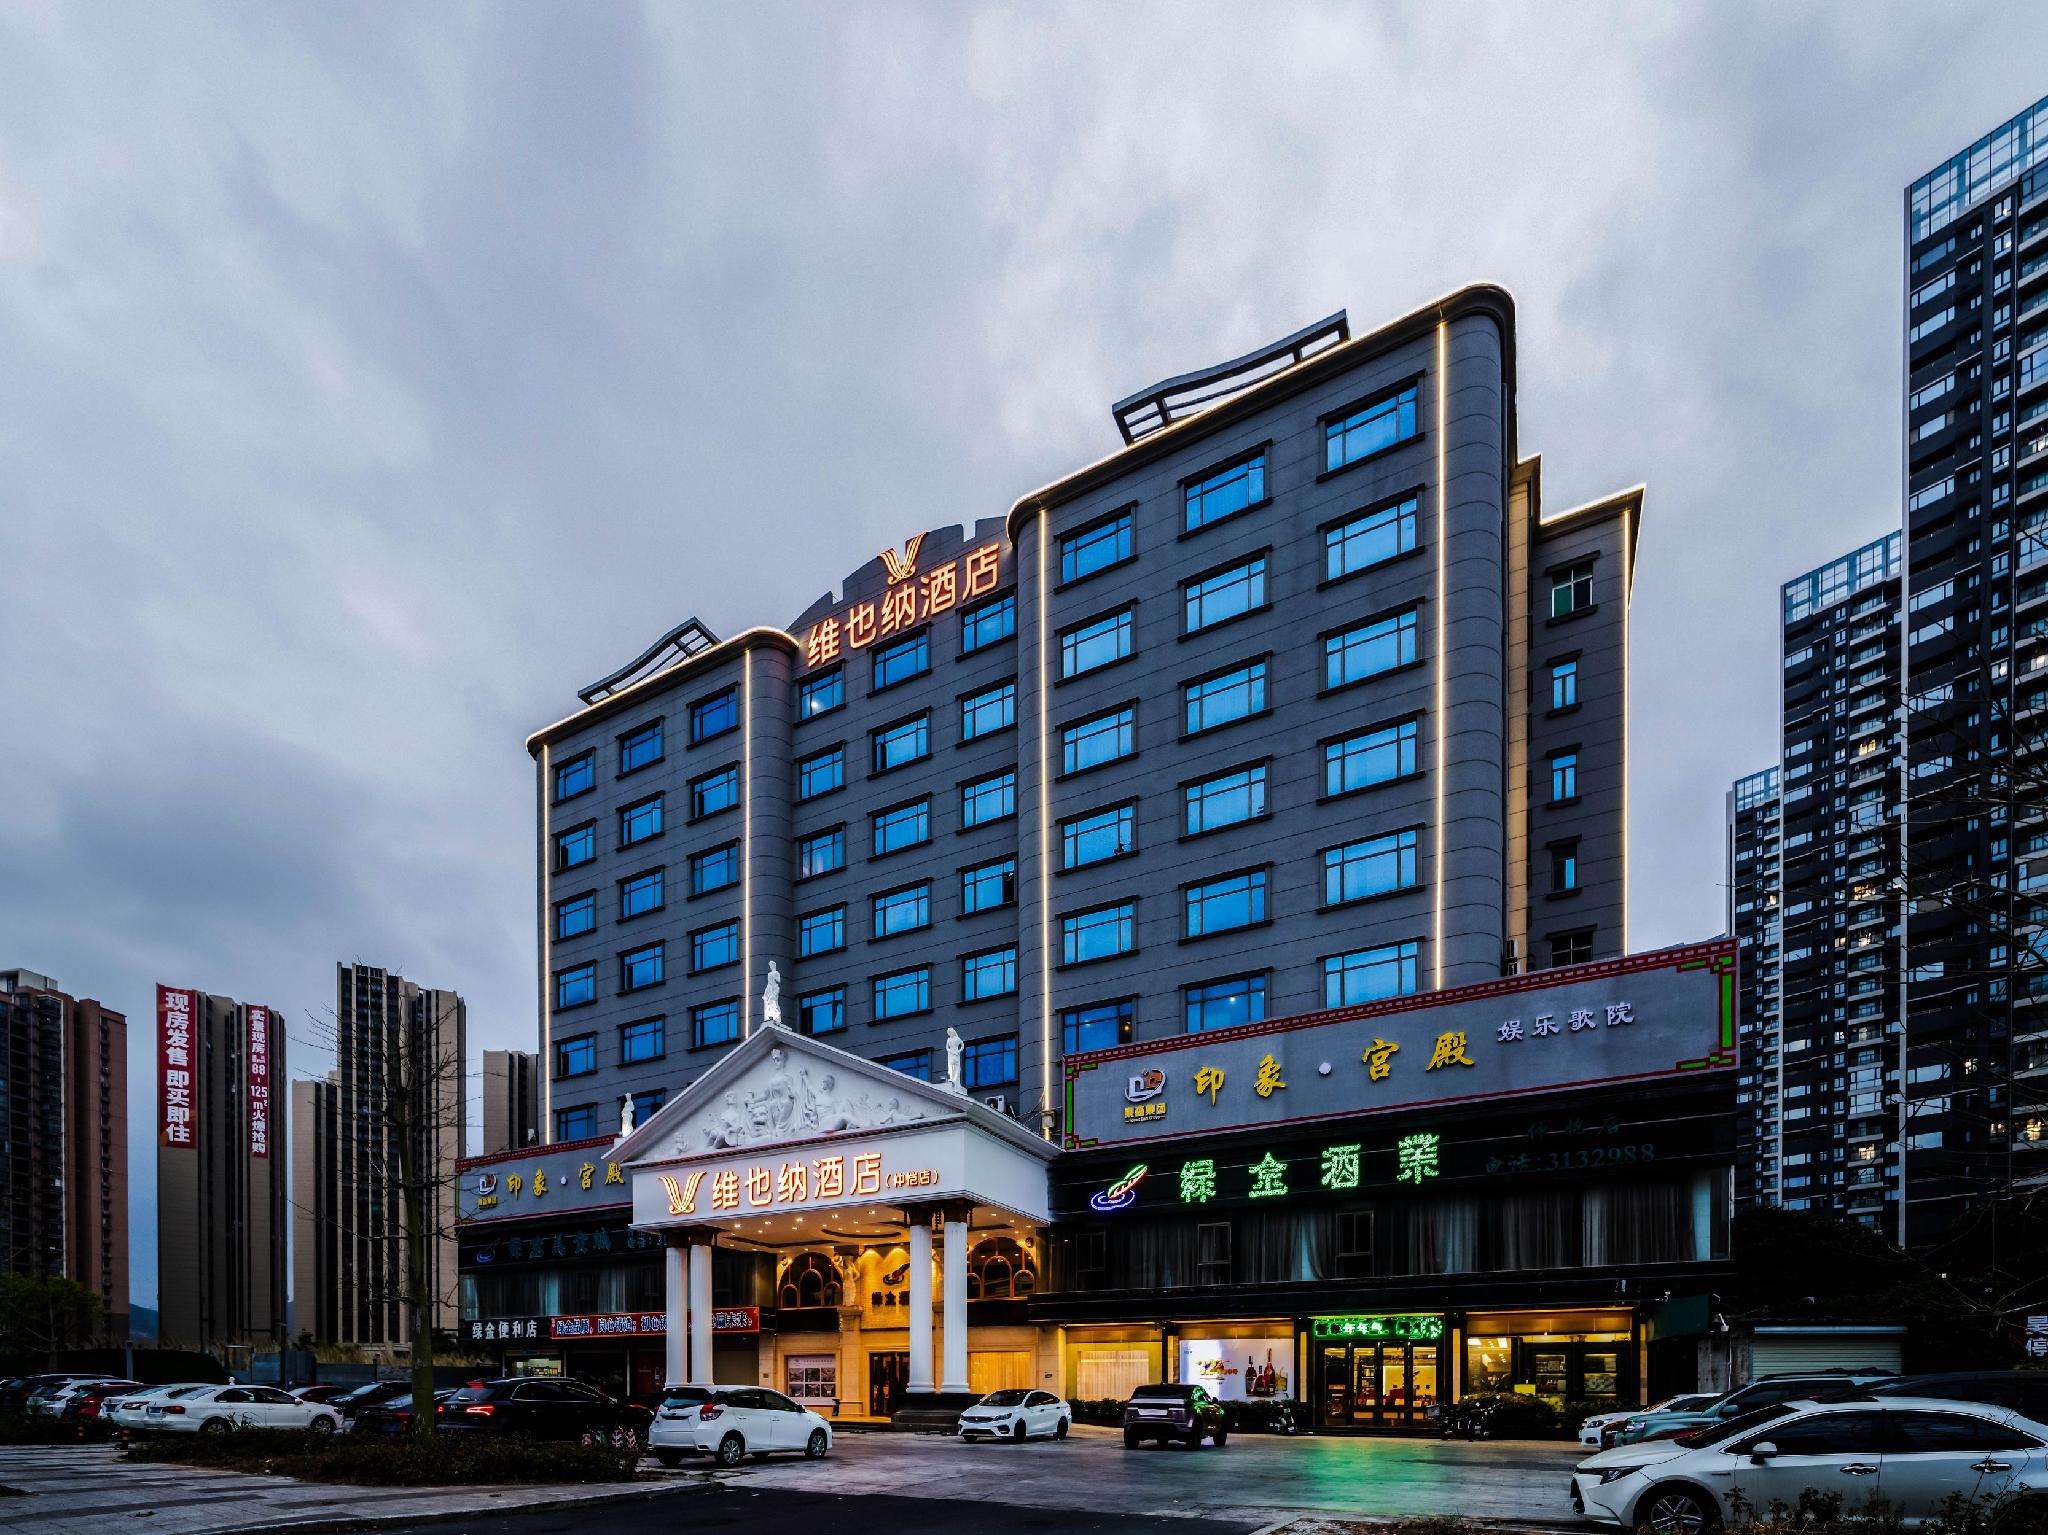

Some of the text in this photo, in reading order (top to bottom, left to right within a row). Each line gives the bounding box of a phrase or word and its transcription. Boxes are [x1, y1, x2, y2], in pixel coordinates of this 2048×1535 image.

[808, 544, 999, 667] 维也纳酒店
[1497, 1002, 1634, 1042] 娱乐歌院
[165, 992, 190, 1143] 现房发售 即买即住
[712, 1152, 882, 1210] 维也纳酒店
[472, 1319, 539, 1340] 绿金便利店
